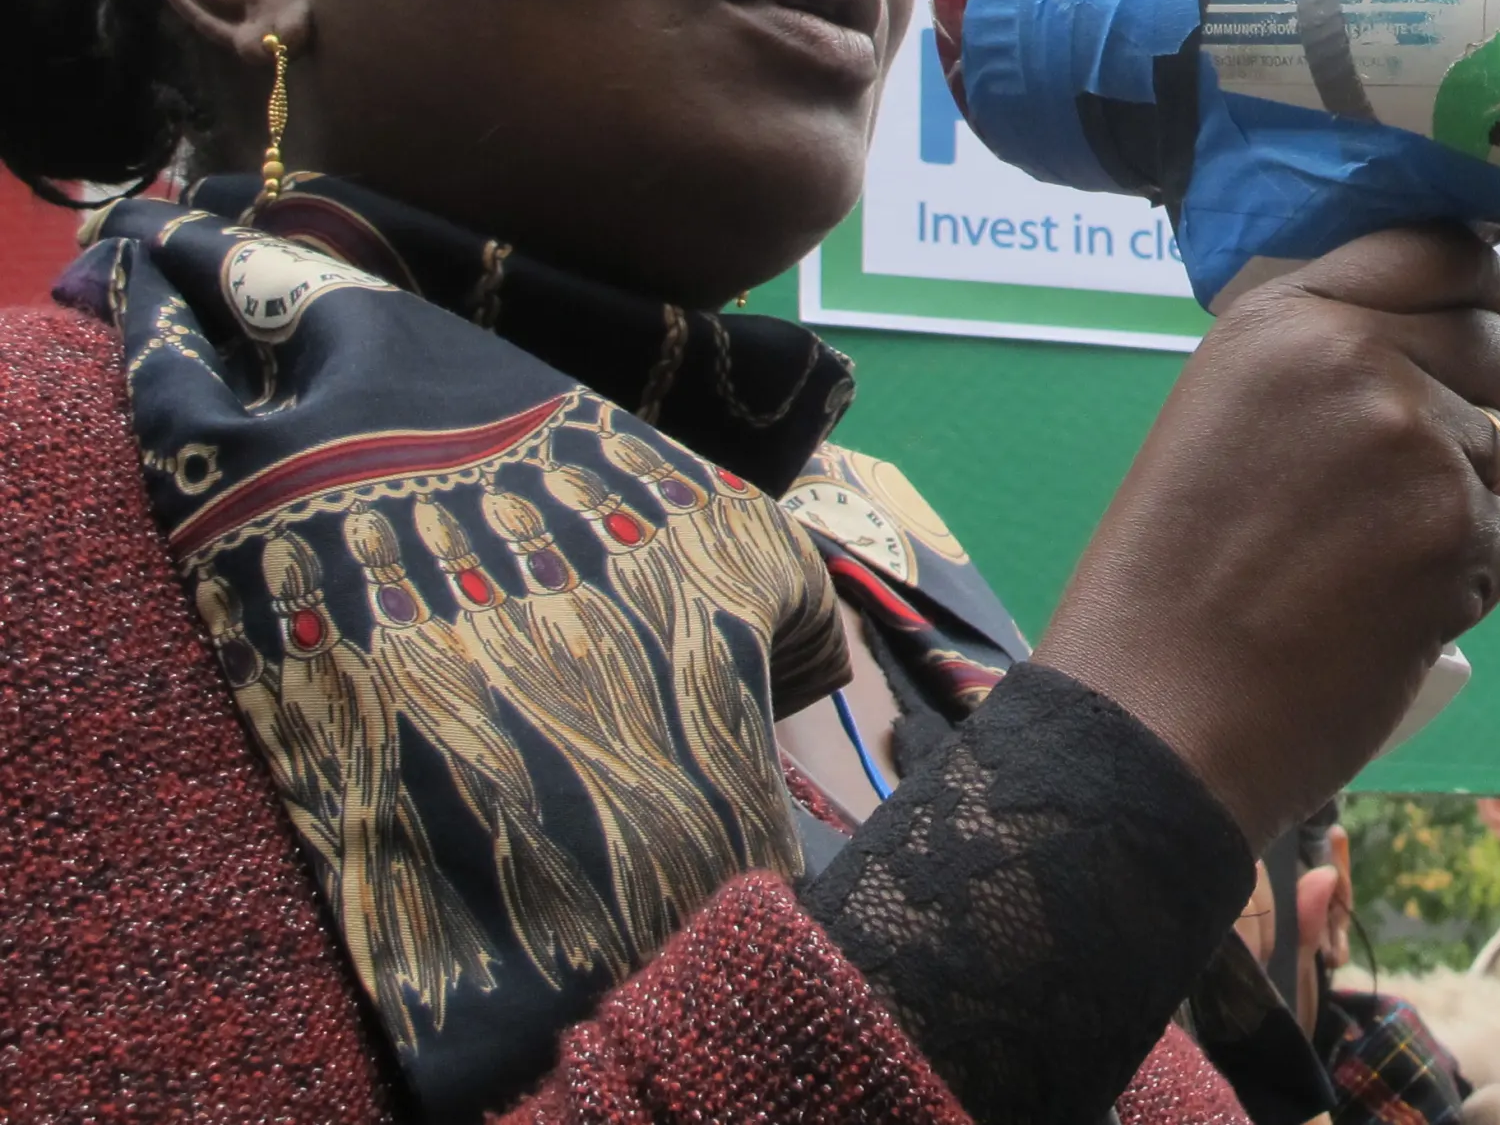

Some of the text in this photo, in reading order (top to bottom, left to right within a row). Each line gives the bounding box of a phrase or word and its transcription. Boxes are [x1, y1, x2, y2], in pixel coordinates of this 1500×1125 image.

[1202, 24, 1267, 36] OMMUNITY
[1259, 55, 1294, 67] TODAY
[917, 201, 1058, 252] Invest
[1074, 213, 1113, 256] in
